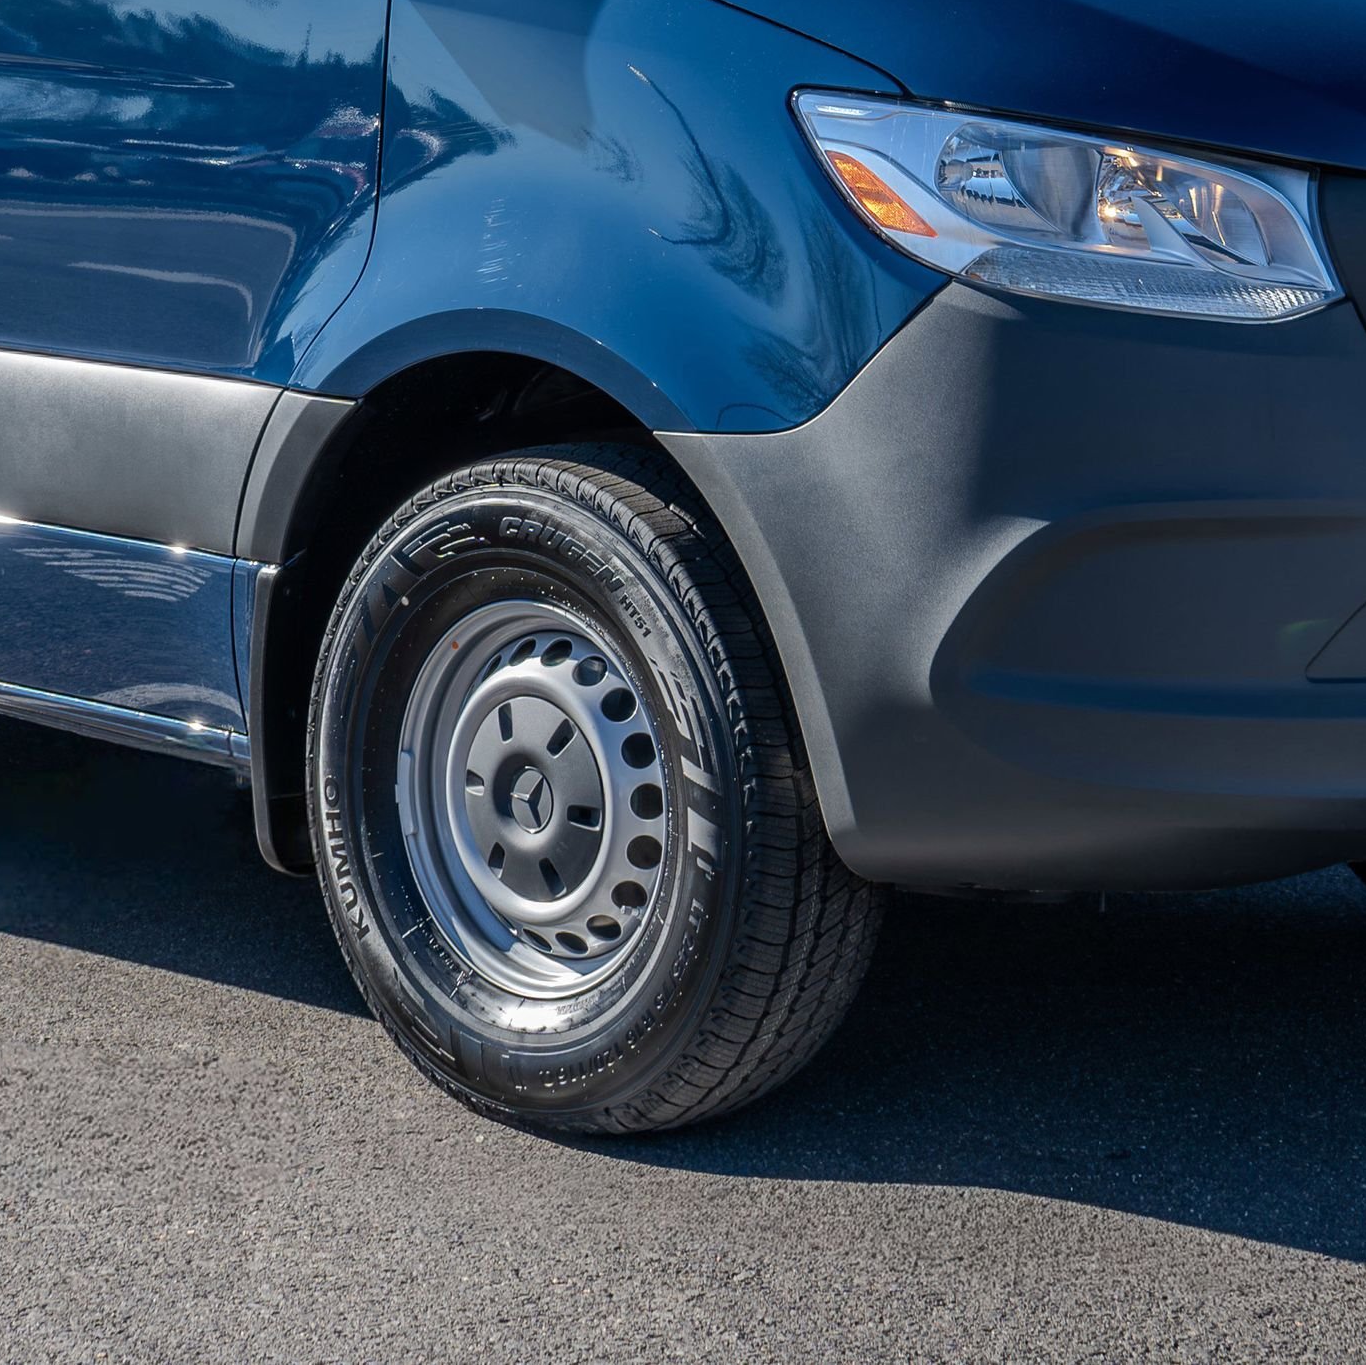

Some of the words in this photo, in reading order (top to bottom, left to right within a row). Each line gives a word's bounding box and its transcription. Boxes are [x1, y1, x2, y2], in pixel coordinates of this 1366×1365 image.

[498, 515, 625, 594] CRUGEN
[618, 592, 652, 638] HT51
[324, 774, 371, 943] KUMHO
